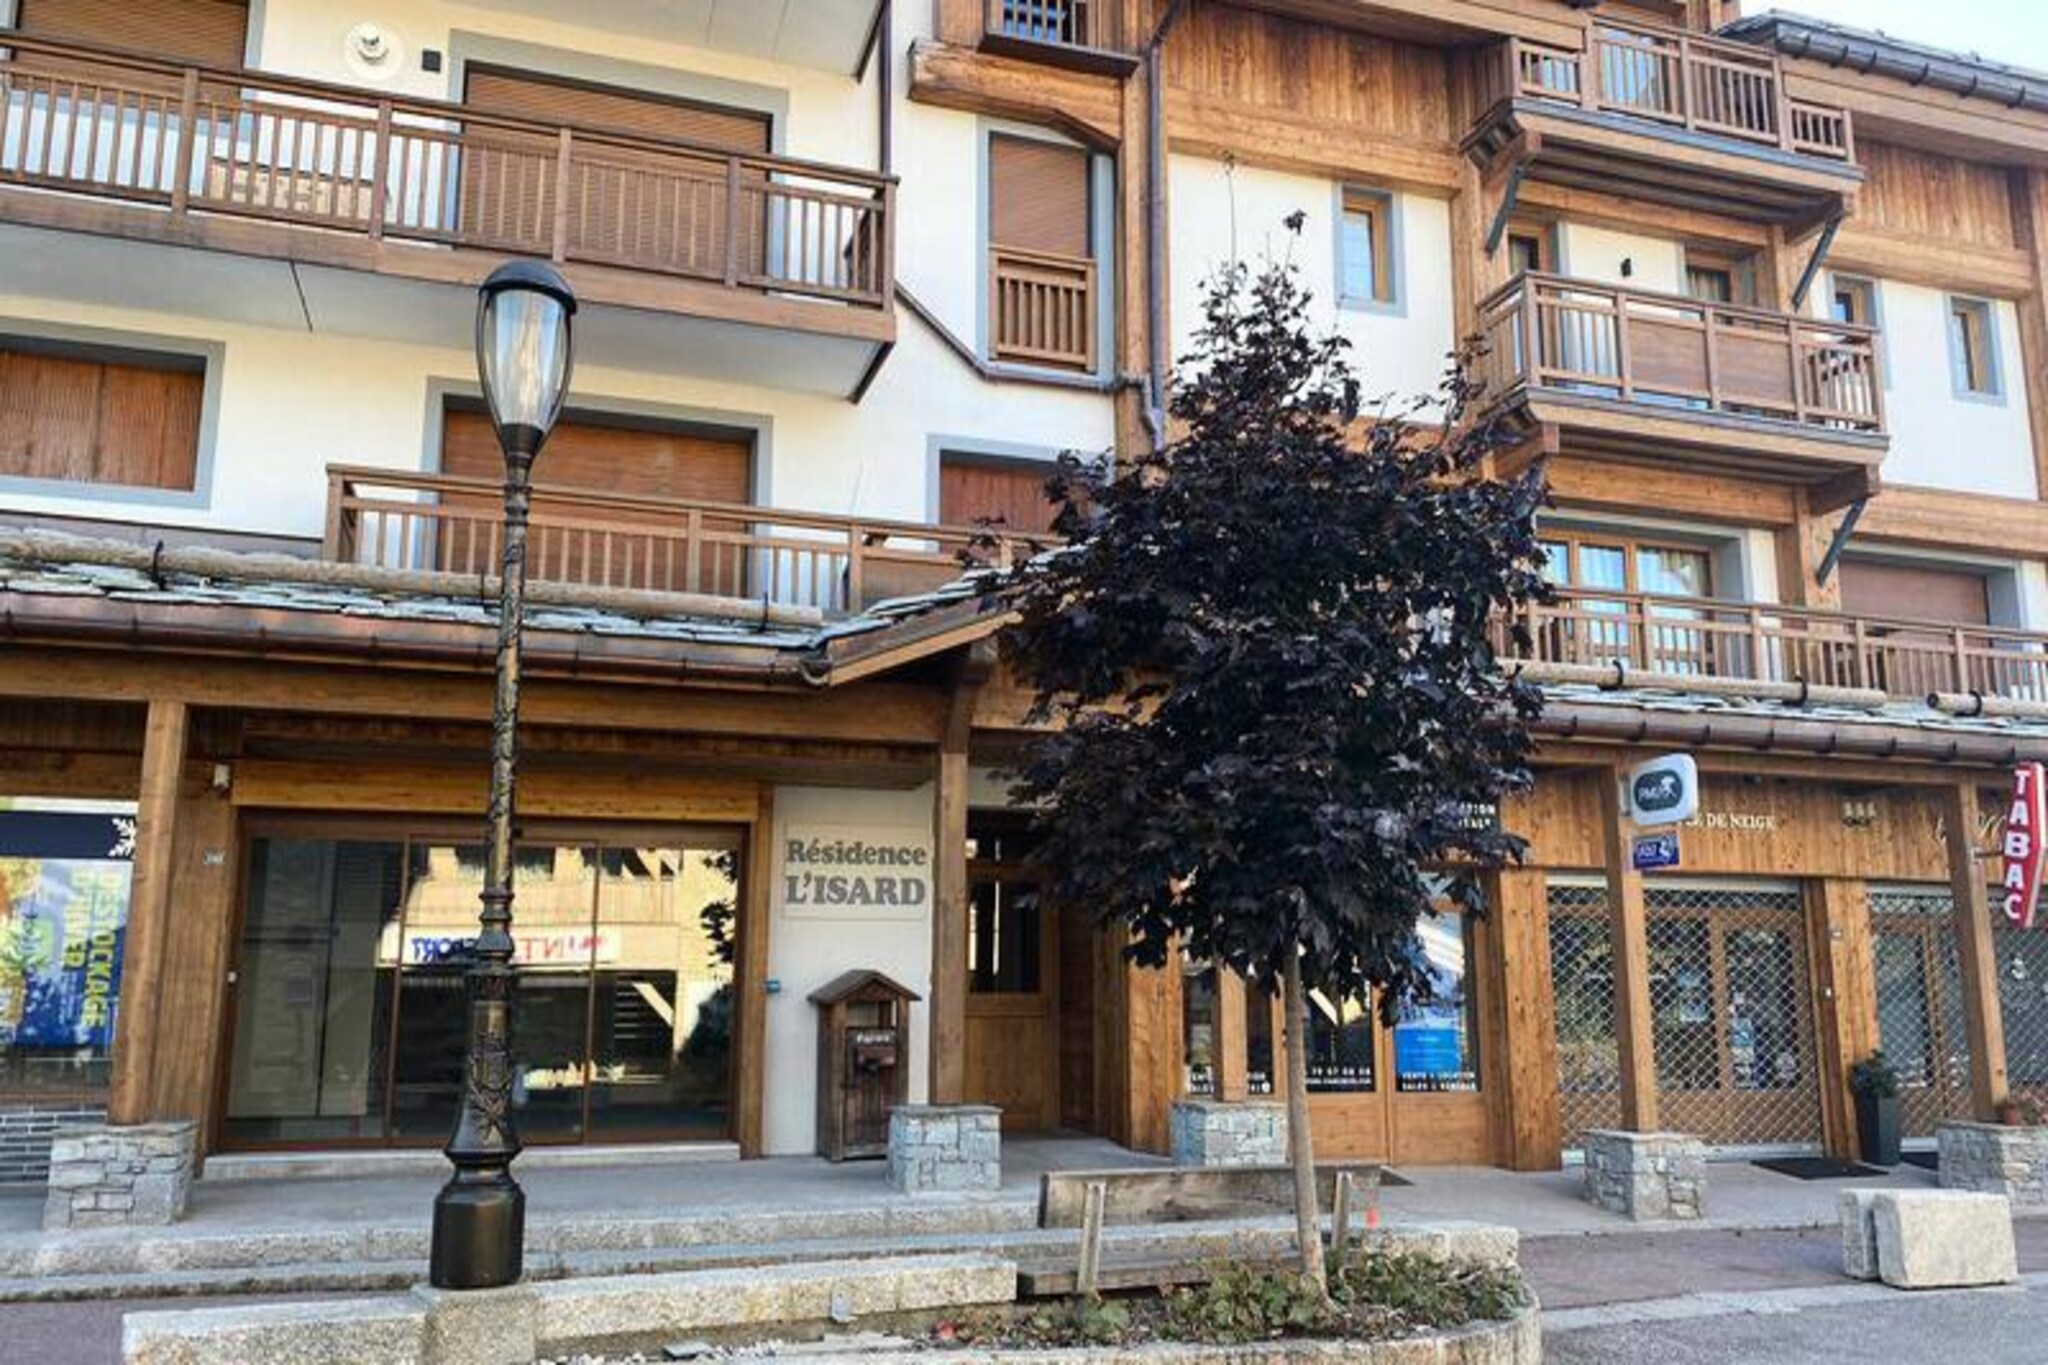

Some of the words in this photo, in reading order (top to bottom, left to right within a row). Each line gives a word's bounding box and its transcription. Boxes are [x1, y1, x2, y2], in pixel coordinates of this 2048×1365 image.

[786, 838, 927, 865] Résidence
[2003, 769, 2031, 919] TABAC
[785, 872, 926, 905] L'ISARD
